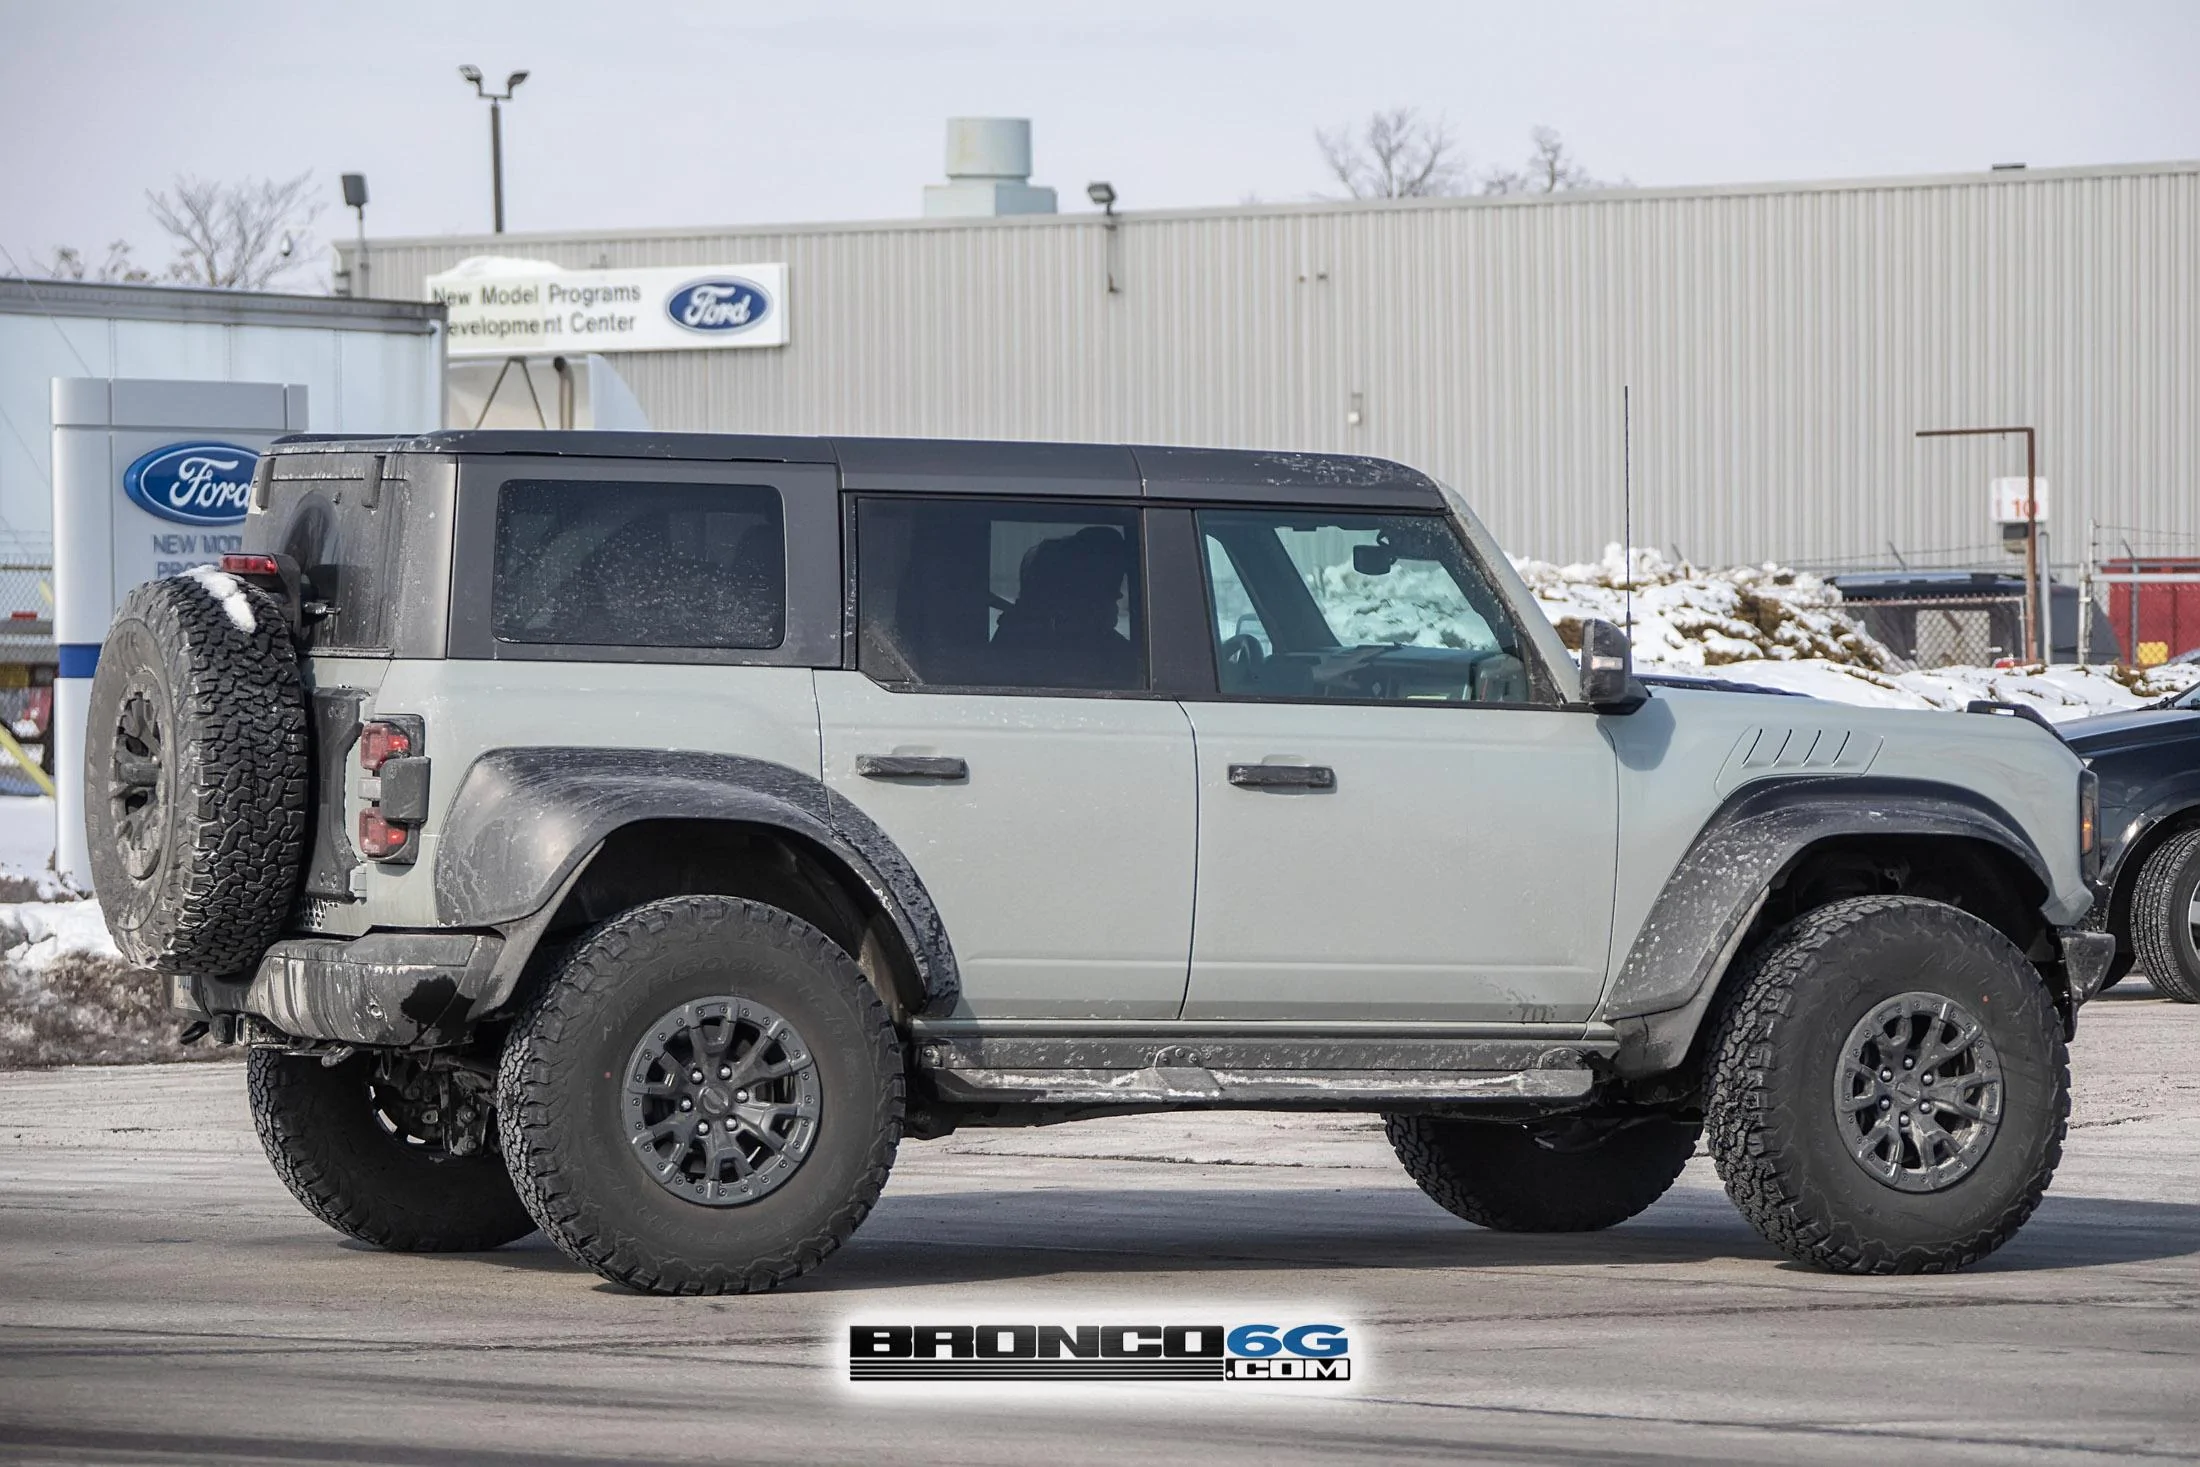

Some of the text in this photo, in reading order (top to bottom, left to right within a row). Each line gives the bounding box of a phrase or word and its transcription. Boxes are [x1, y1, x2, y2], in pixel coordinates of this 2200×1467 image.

[432, 282, 642, 307] New Model Programs
[683, 285, 751, 326] Ford
[448, 310, 637, 338] evelopment Center
[153, 534, 197, 555] NEW
